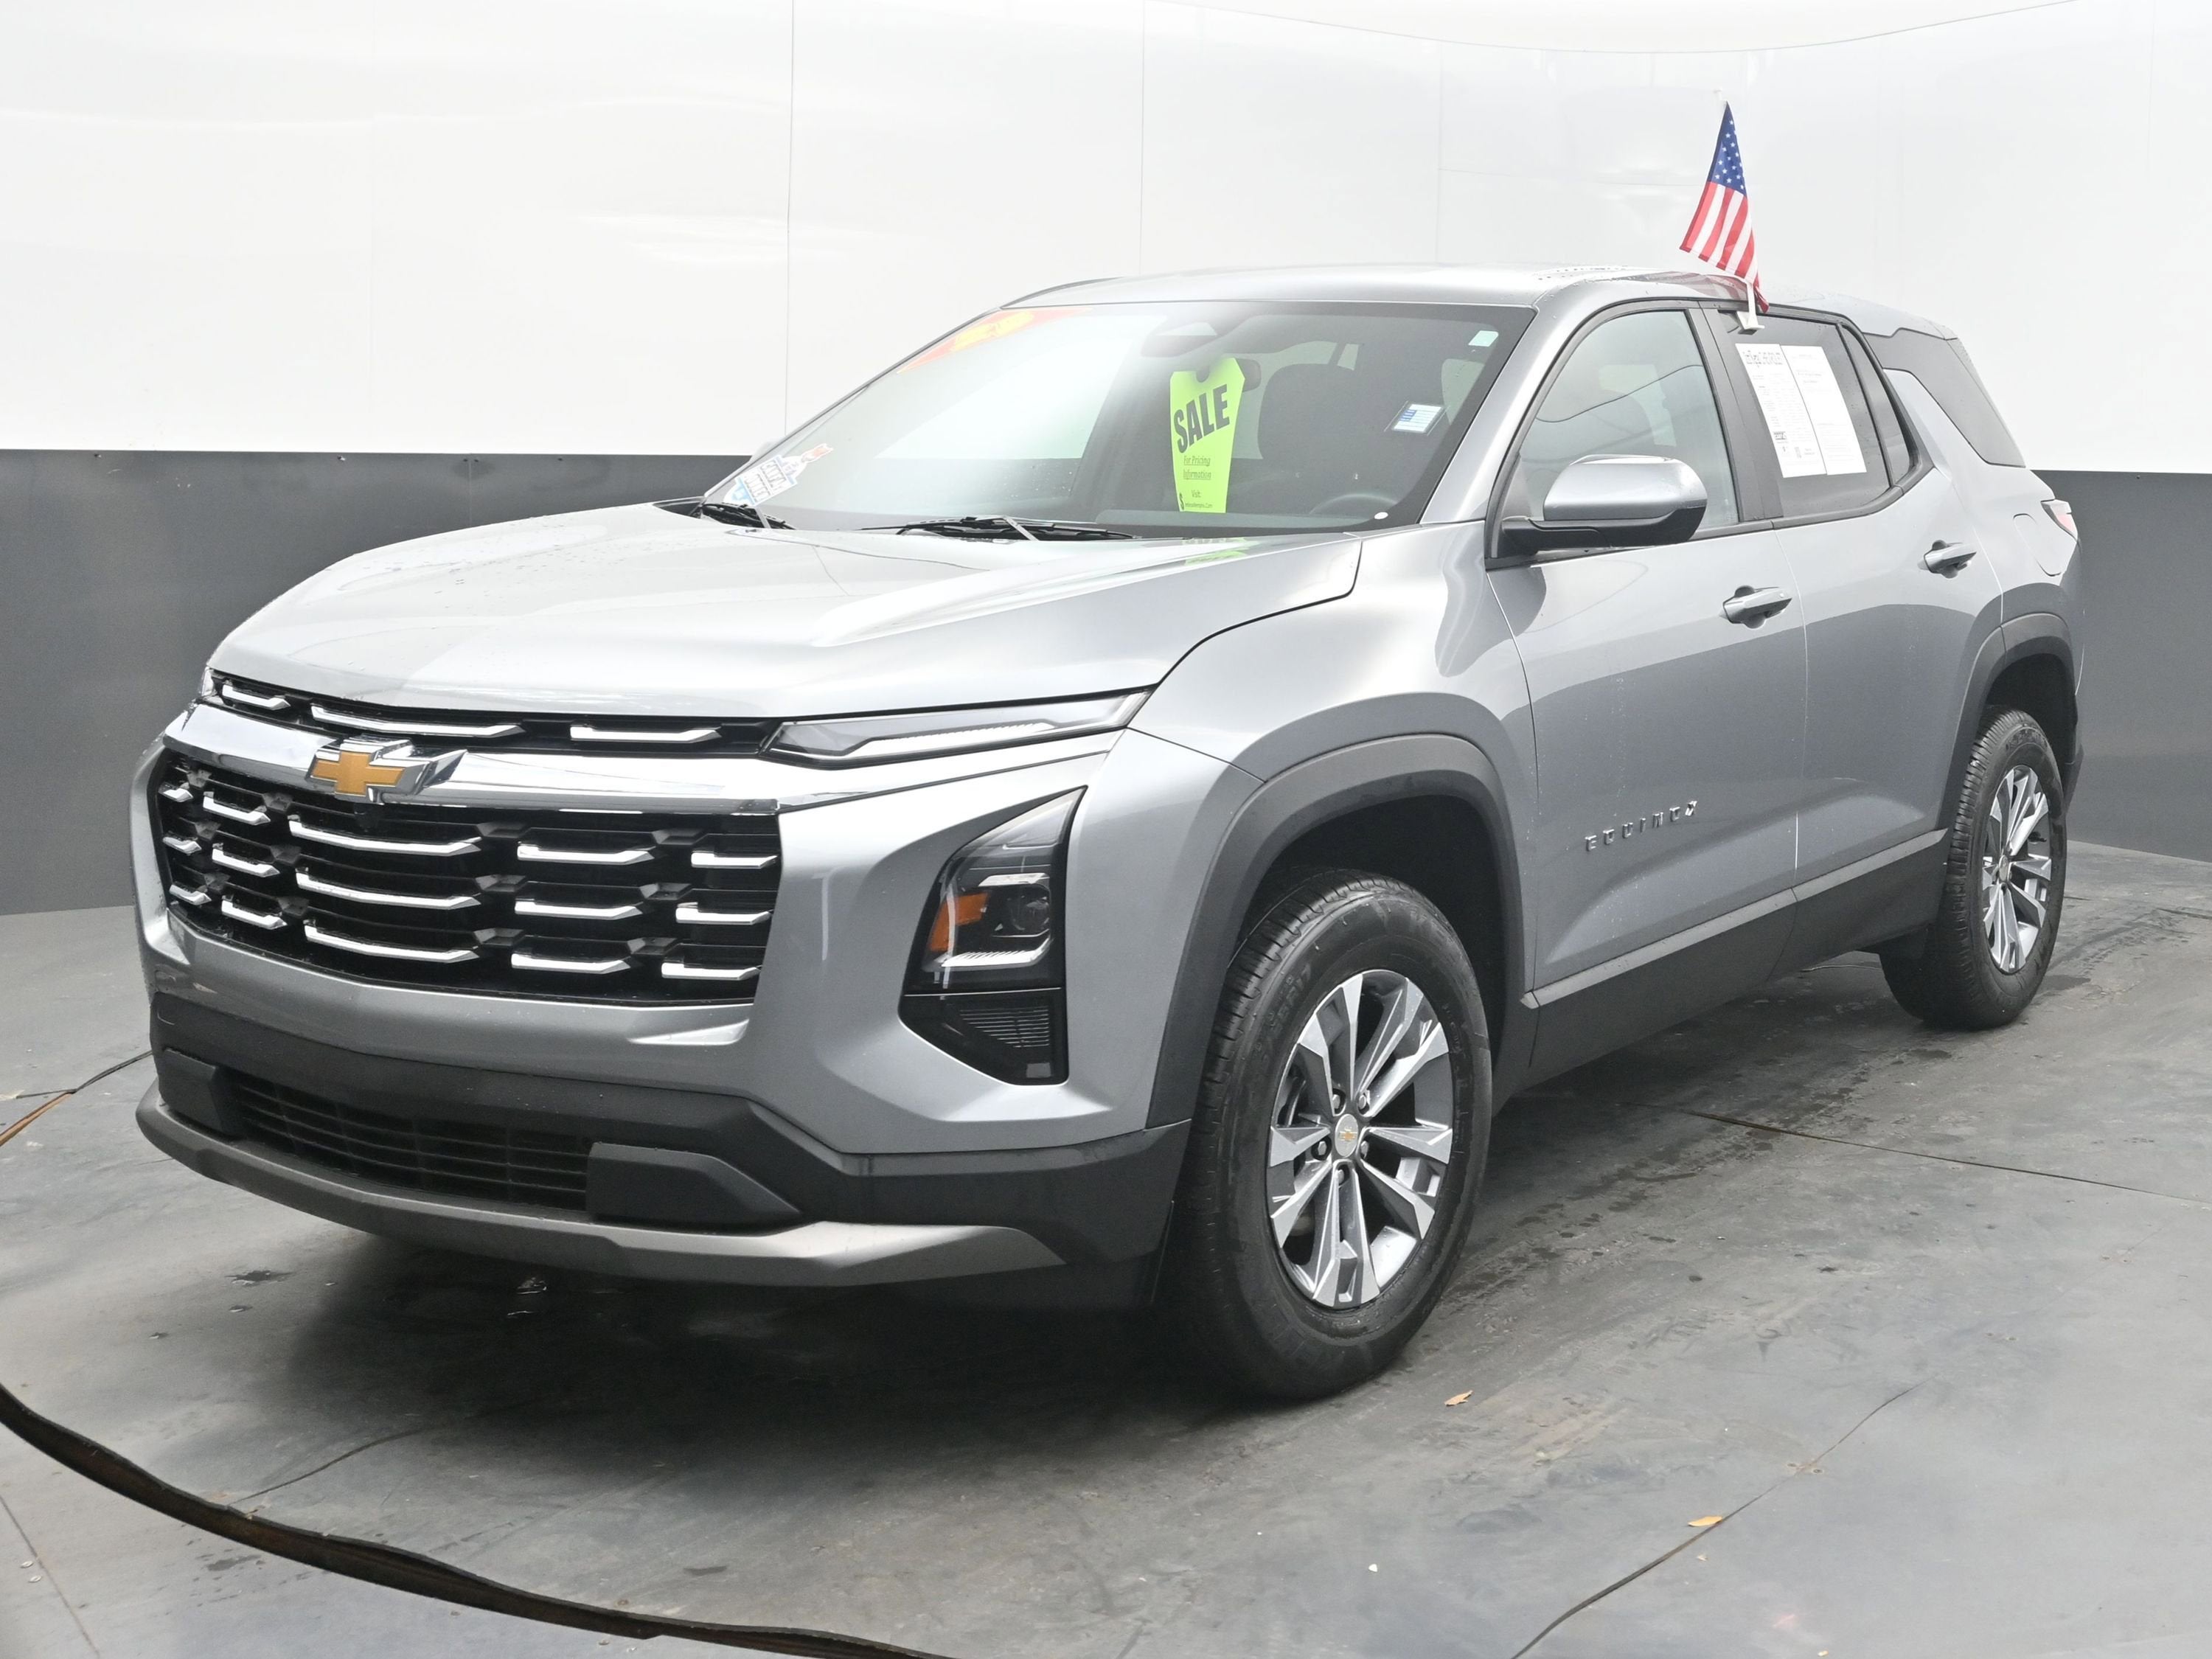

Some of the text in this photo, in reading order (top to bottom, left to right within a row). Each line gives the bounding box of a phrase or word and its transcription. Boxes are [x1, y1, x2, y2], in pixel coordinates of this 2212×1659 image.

[1174, 383, 1230, 453] SALE
[1183, 469, 1211, 479] Information
[1192, 455, 1211, 467] Pricing
[1585, 801, 1698, 852] EQUINOX
